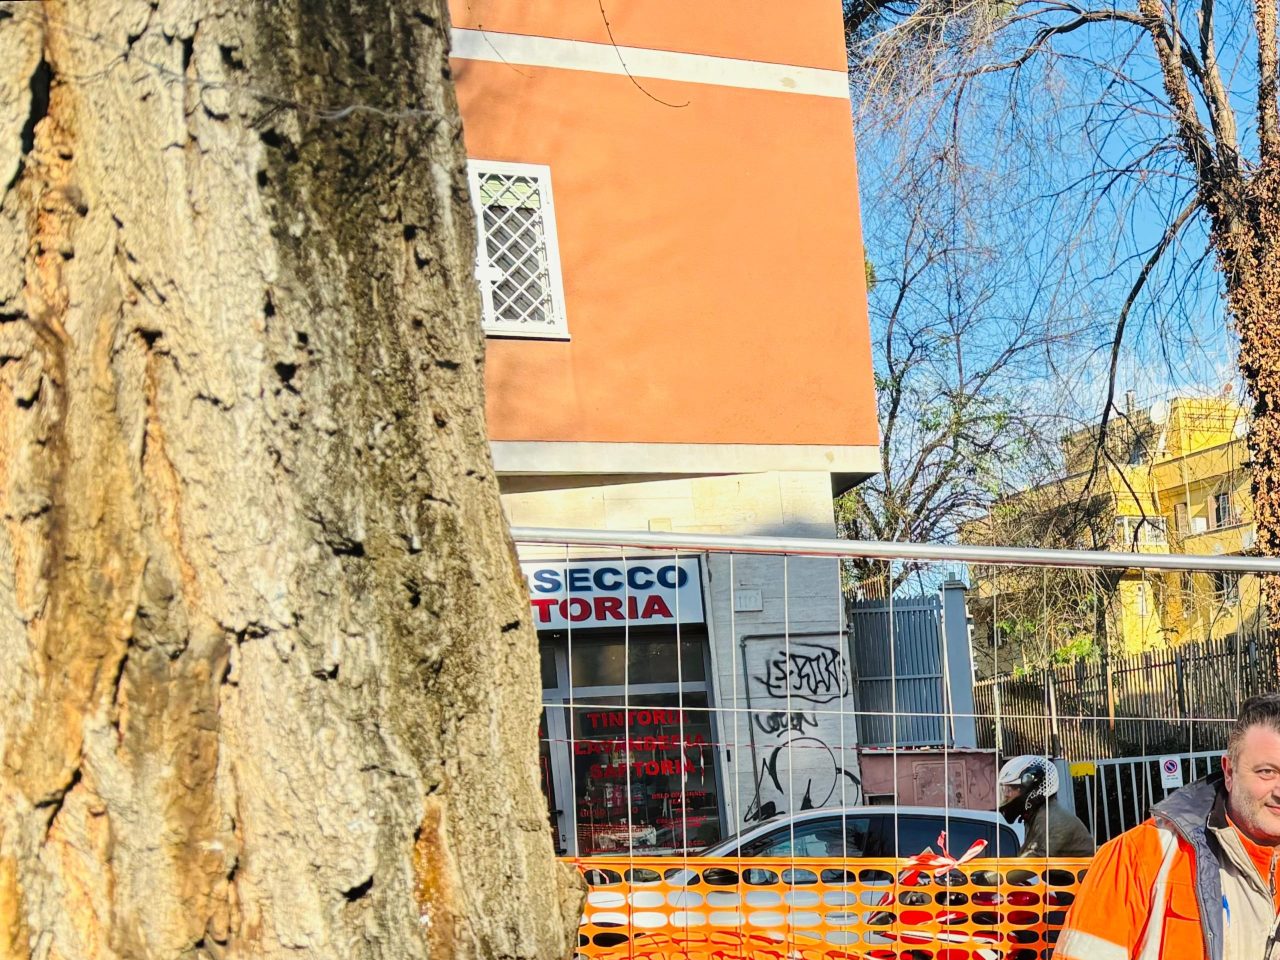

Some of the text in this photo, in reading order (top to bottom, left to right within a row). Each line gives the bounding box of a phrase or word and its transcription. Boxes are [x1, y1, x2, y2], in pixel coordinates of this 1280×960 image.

[531, 565, 688, 593] SECCO
[531, 595, 674, 622] TORIA
[587, 709, 689, 729] TINTORIA
